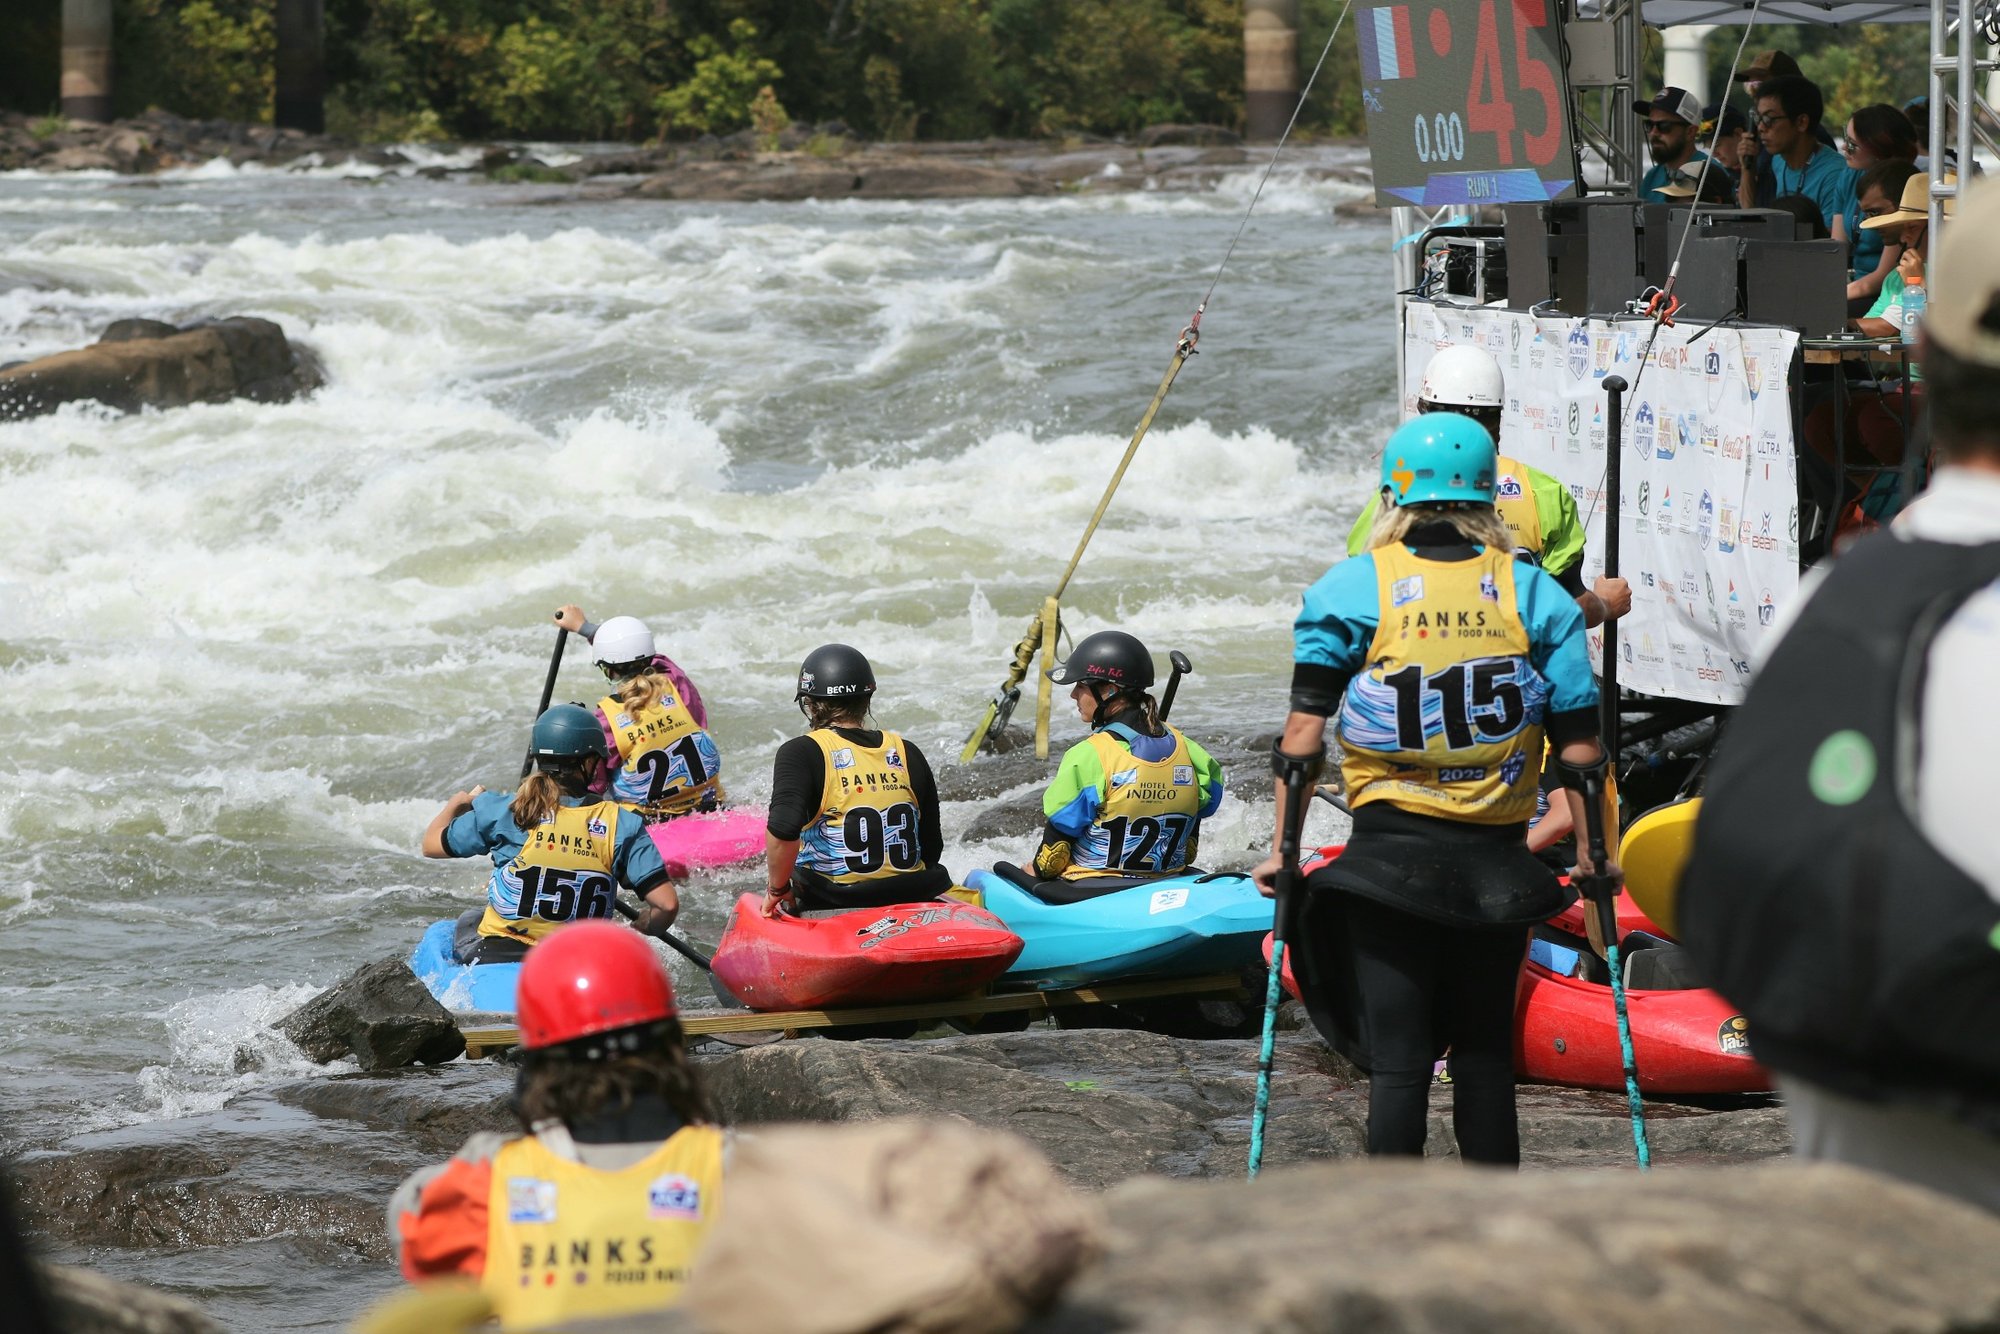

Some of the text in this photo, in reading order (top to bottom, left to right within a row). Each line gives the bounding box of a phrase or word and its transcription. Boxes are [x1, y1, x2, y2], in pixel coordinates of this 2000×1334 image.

[1467, 0, 1562, 166] 45
[1414, 111, 1465, 163] 0.00
[1466, 176, 1498, 198] RUN 1
[1569, 347, 1588, 355] ALWAYS
[1757, 441, 1781, 456] ULTRA
[1500, 484, 1520, 495] ACA
[1401, 610, 1486, 630] BANKS
[1457, 629, 1507, 639] FOOD HALL
[1383, 660, 1526, 751] 115
[627, 715, 673, 742] BANKS
[660, 720, 687, 734] FOOD HALL
[636, 734, 708, 801] 21
[841, 772, 898, 788] BANKS
[1126, 789, 1177, 800] INDIGO
[588, 824, 605, 834] ACA
[842, 802, 919, 874] 93
[536, 831, 593, 850] BANKS
[1100, 815, 1188, 871] 127
[573, 848, 590, 857] FOOD
[513, 865, 611, 922] 156
[520, 1236, 655, 1268] BANKS
